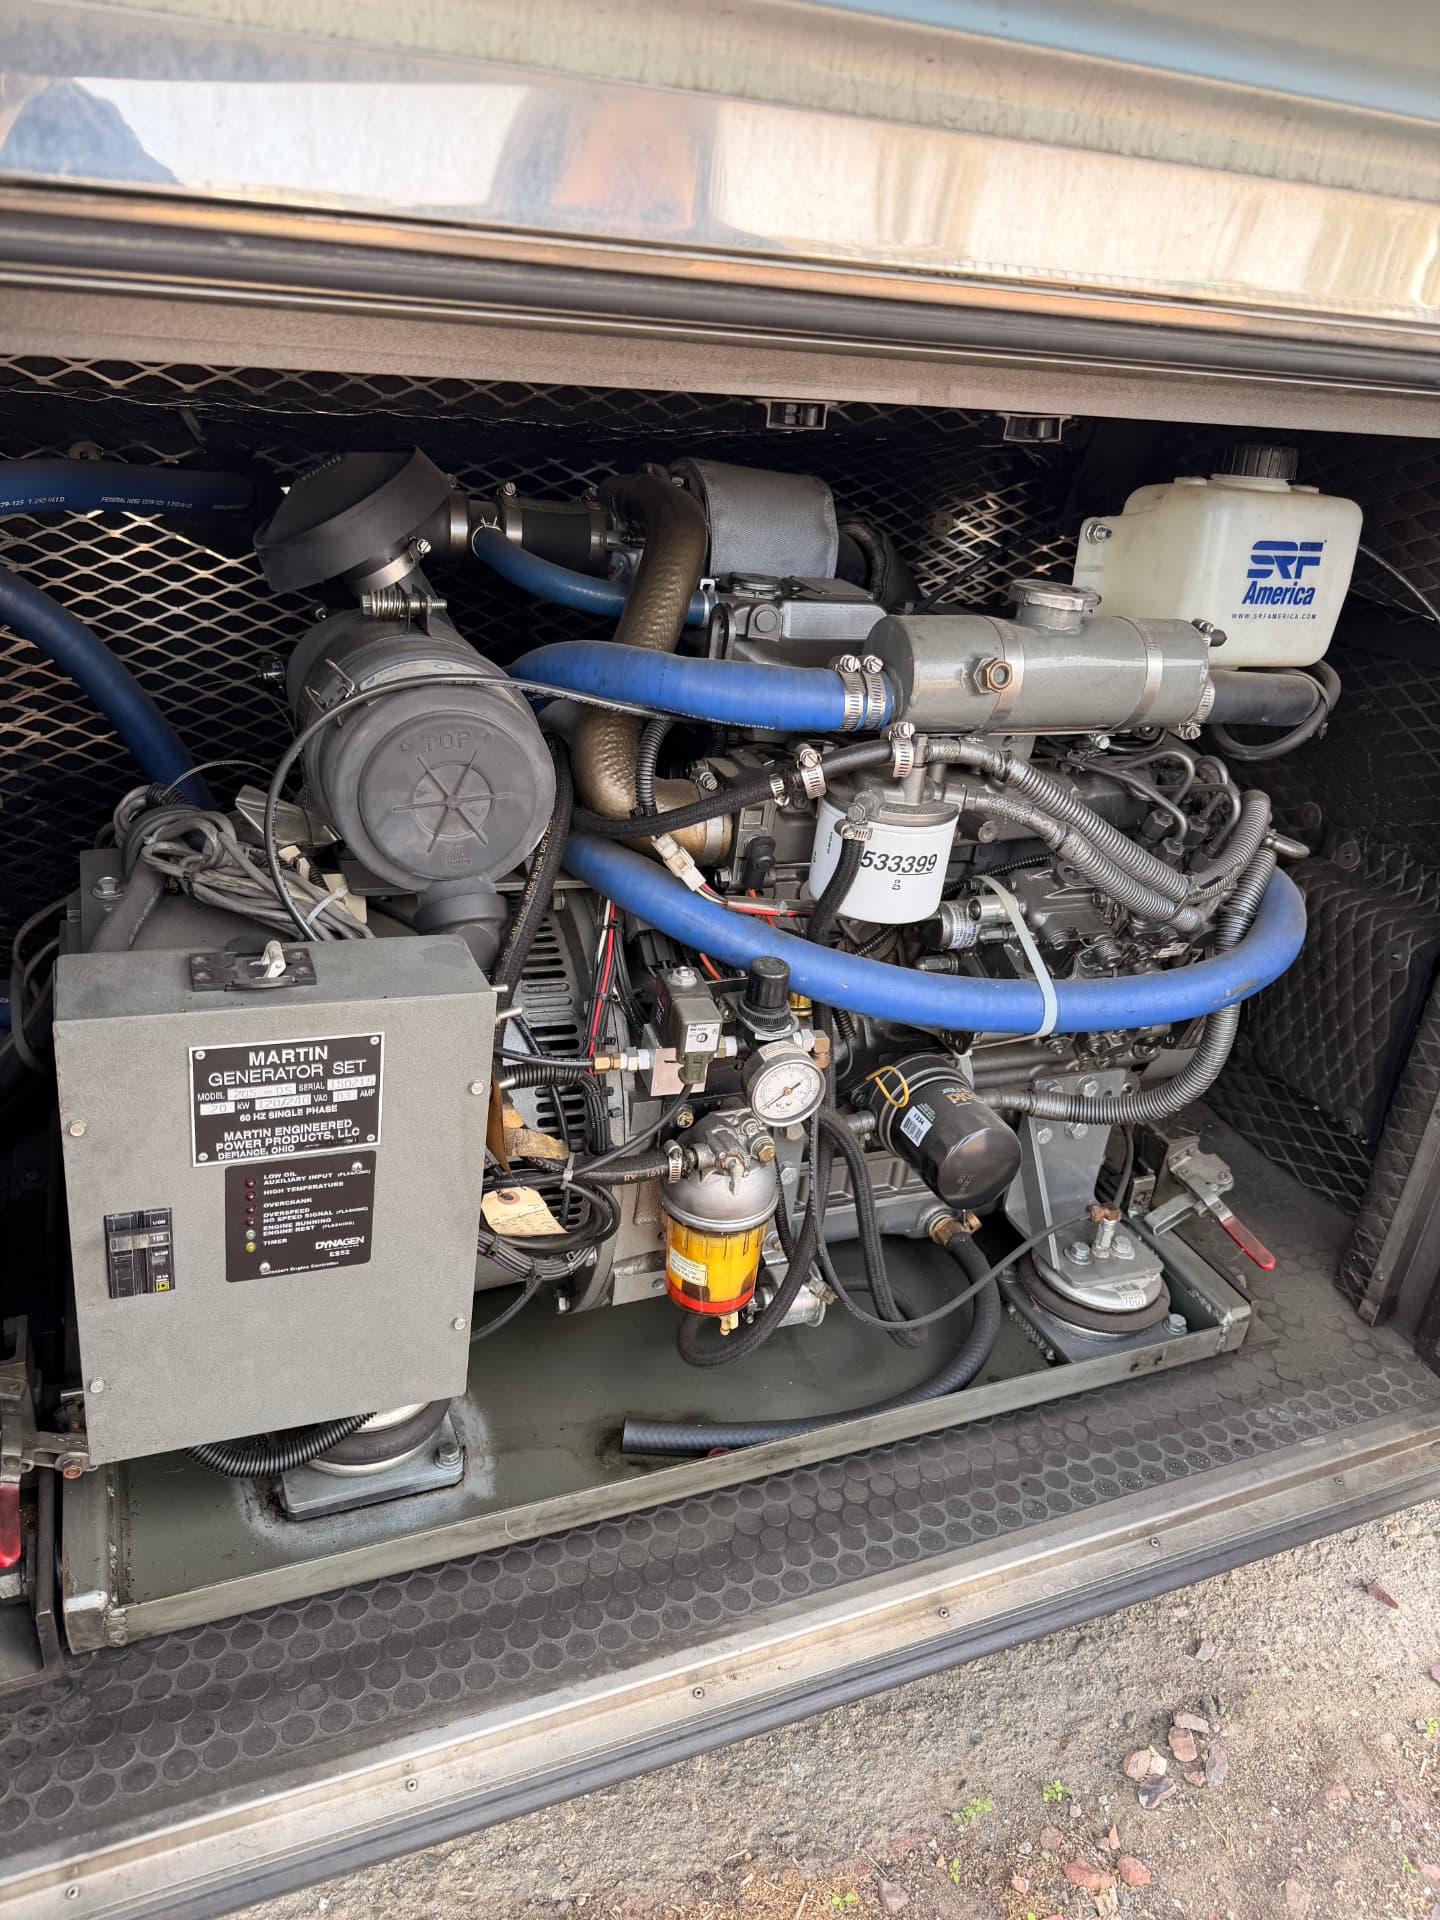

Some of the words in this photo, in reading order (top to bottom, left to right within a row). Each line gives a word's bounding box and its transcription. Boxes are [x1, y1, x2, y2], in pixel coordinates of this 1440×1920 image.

[1247, 540, 1323, 579] SRF
[1241, 580, 1316, 605] America
[1231, 612, 1317, 620] WWW.SRFAMERICA.COM
[422, 730, 471, 752] TOP
[860, 850, 938, 873] 533399
[249, 1046, 328, 1067] MARTIN
[208, 1063, 324, 1087] GENERATOR
[332, 1059, 367, 1075] SET
[197, 1092, 225, 1102] MODEL
[298, 1083, 326, 1092] SERIAL
[359, 1089, 376, 1097] AMP
[239, 1114, 251, 1122] 60
[253, 1112, 267, 1121] HZ
[268, 1108, 304, 1119] SINGLE
[305, 1104, 338, 1115] PHASE
[224, 1128, 272, 1142] MARTIN
[275, 1119, 353, 1136] ENGINEERED
[215, 1140, 262, 1152] POWER
[265, 1131, 335, 1146] PRODUCTS,
[337, 1127, 360, 1137] LLC
[217, 1148, 269, 1160] DEFIANCE,
[271, 1145, 295, 1154] OHIO
[263, 1176, 306, 1186] AUXILIARY
[263, 1188, 284, 1196] HIGH
[286, 1181, 345, 1193] TEMPERATURE
[263, 1197, 313, 1208] OVERCRANK
[263, 1207, 311, 1218] OVERSPEED
[277, 1214, 303, 1222] SPEED
[304, 1210, 334, 1218] SIGNAL
[263, 1222, 294, 1231] ENGINE
[295, 1217, 332, 1227] RUNNING
[263, 1228, 294, 1237] ENGINE
[295, 1225, 316, 1233] REST
[263, 1238, 288, 1246] TIMER
[315, 1236, 365, 1250] DYNAGEN
